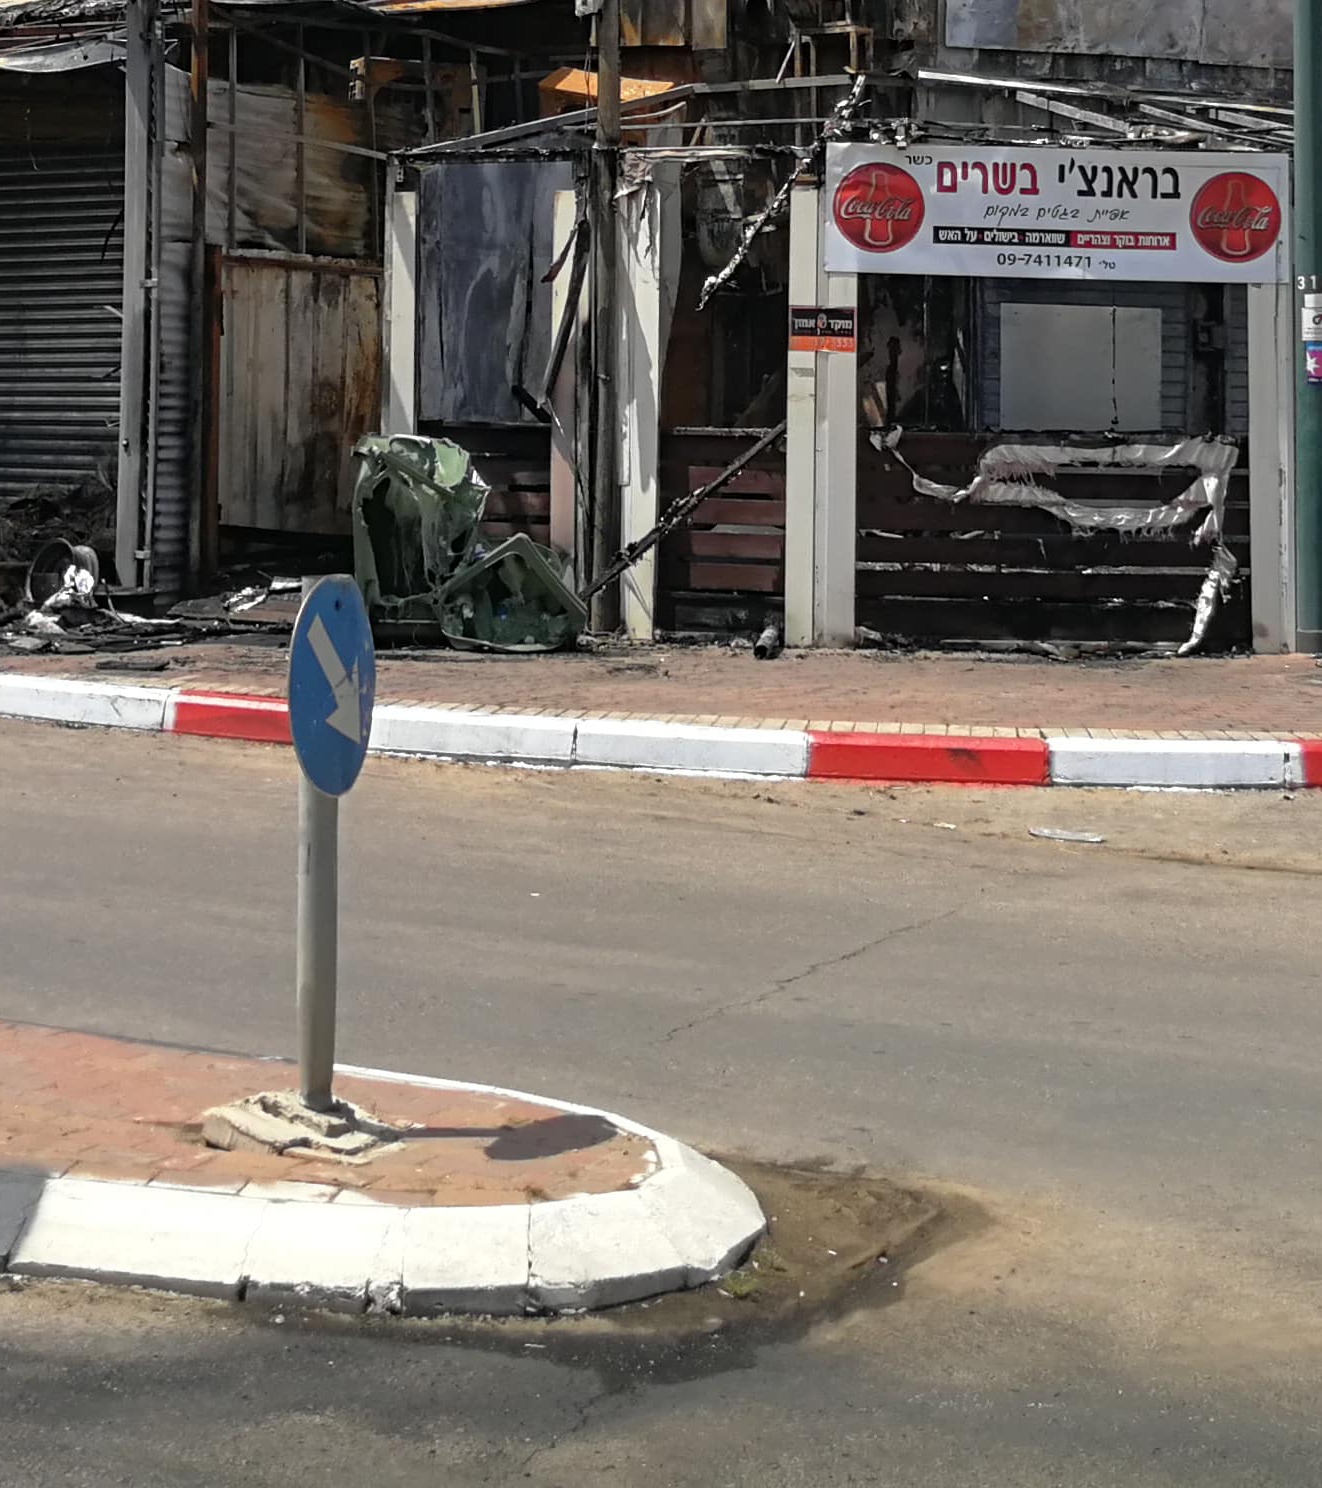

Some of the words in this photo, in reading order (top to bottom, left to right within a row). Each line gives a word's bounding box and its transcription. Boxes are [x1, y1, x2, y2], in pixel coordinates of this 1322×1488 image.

[904, 155, 933, 166] כשר
[936, 161, 1040, 195] בשרים
[1057, 157, 1182, 200] בראנצ'י
[983, 203, 1030, 228] במקום
[938, 229, 962, 241] האש
[964, 228, 978, 243] על
[1113, 234, 1136, 248] בוקר
[996, 252, 1092, 269] 09-7411471
